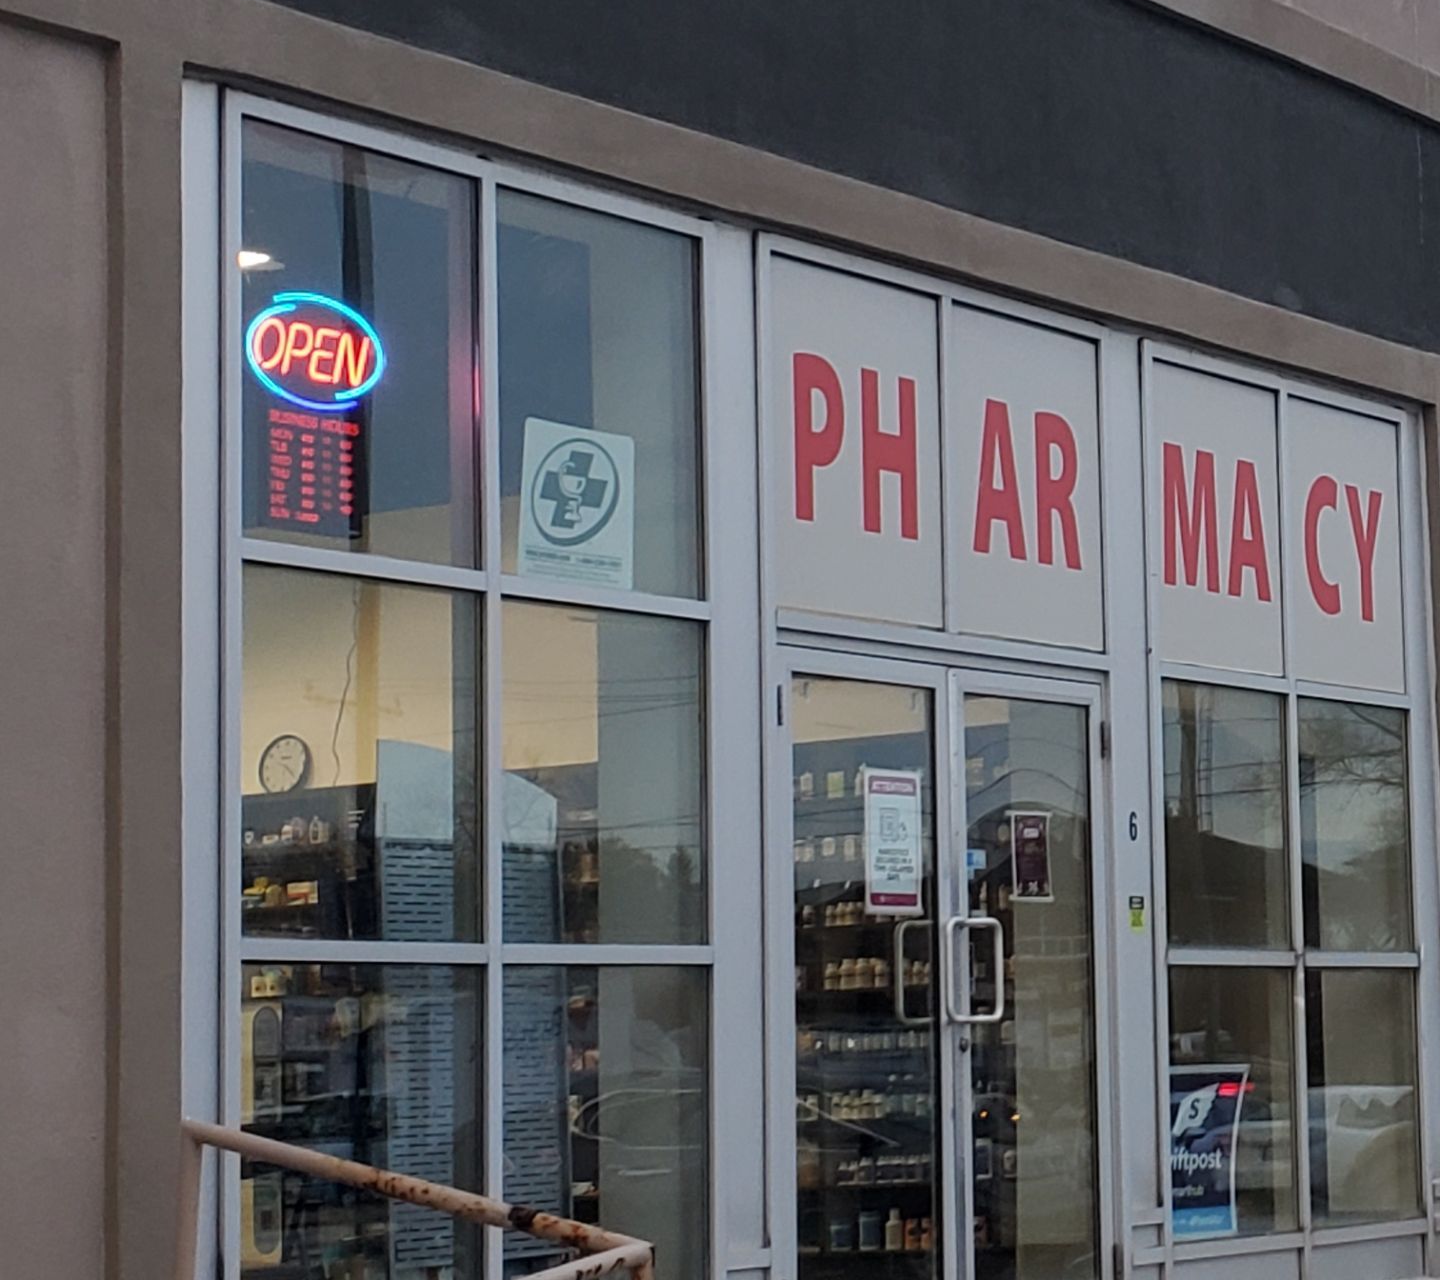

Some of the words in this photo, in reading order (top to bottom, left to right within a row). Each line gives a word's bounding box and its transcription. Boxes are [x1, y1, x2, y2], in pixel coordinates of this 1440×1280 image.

[253, 317, 371, 388] OPEN
[1129, 811, 1138, 841] 6
[1188, 1098, 1200, 1120] S
[1170, 1147, 1222, 1176] iftpost
